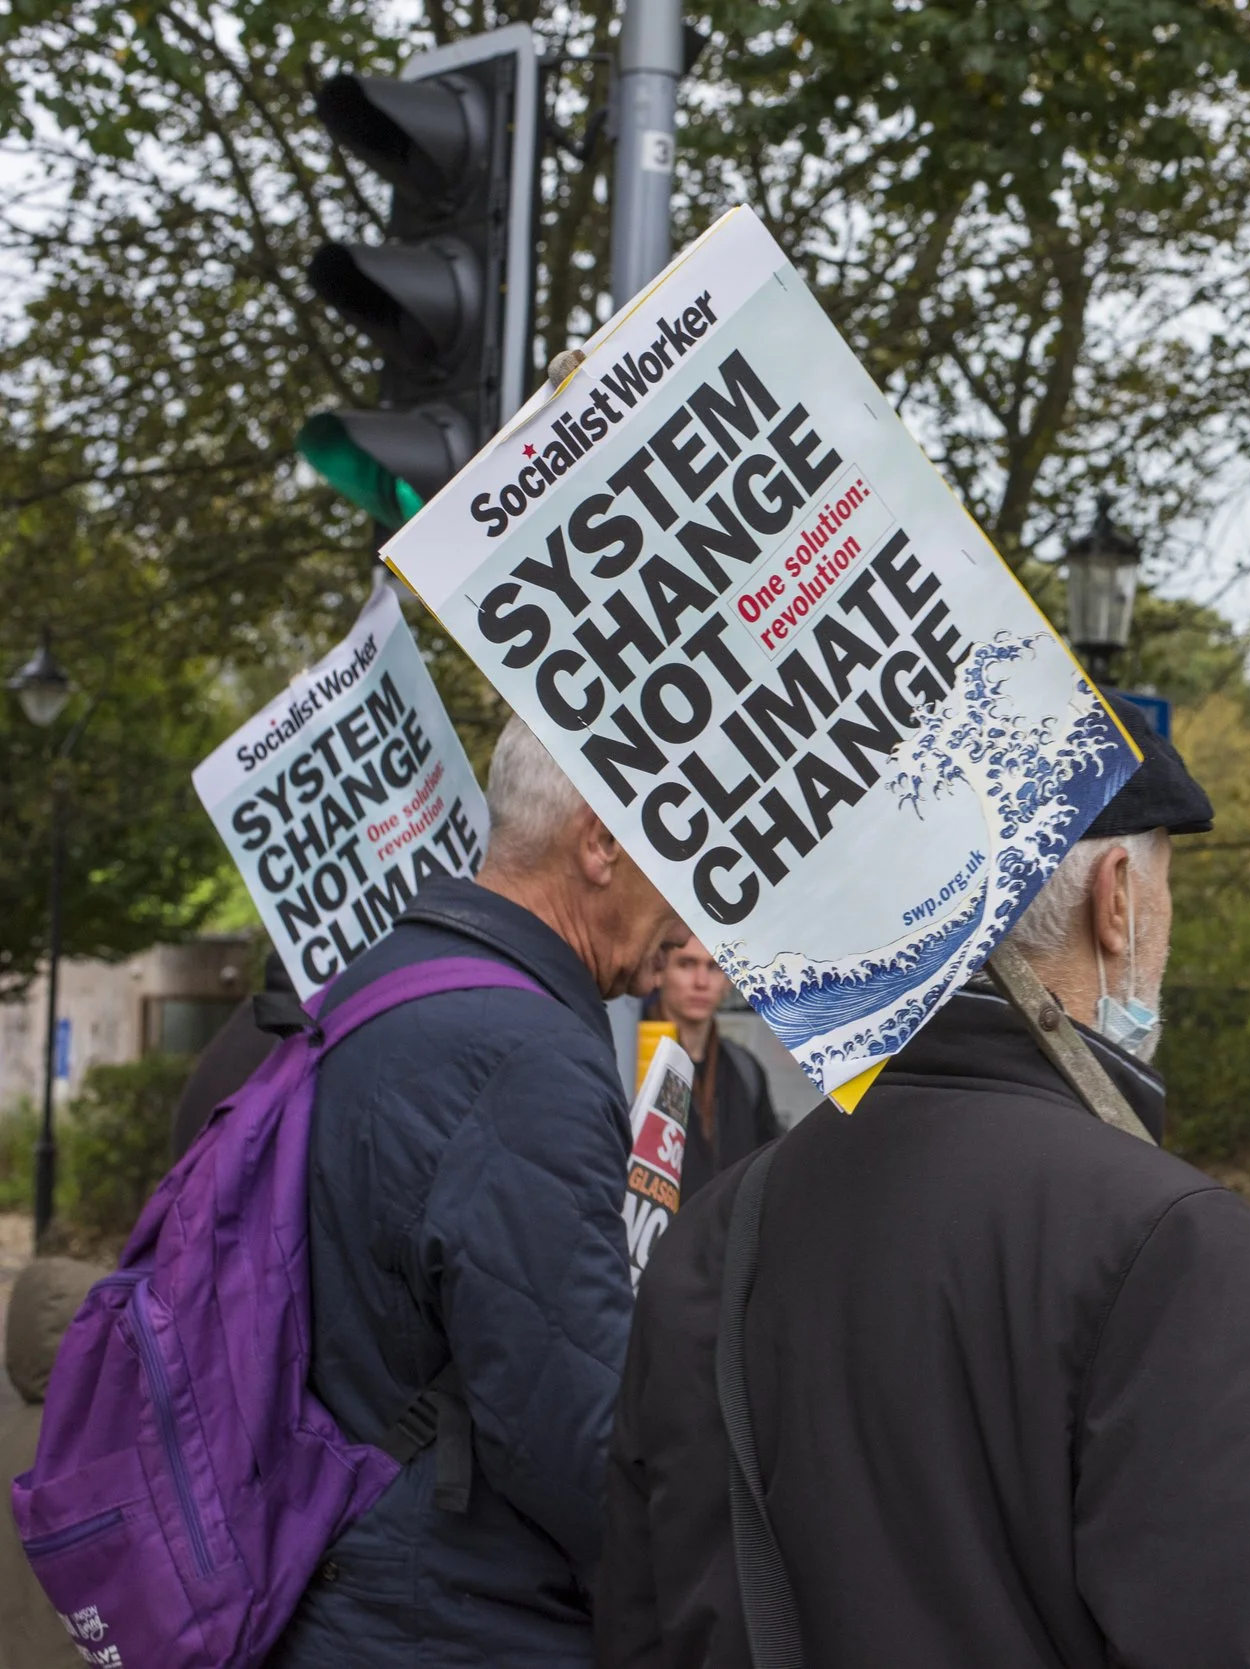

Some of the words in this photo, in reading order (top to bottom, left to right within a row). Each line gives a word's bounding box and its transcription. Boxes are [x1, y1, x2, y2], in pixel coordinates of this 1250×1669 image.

[470, 388, 624, 538] Socialist
[600, 290, 719, 409] Worker
[478, 348, 781, 669] SYSTEM
[537, 403, 843, 732] CHANGE
[737, 573, 786, 623] One
[784, 479, 871, 578] solution:
[760, 534, 862, 650] revolution
[231, 670, 406, 852] SYSTEM
[236, 690, 322, 772] Socialist
[314, 633, 379, 703] Worker
[580, 611, 753, 808] NOT
[641, 528, 942, 862] CLIMATE
[692, 599, 974, 926] CHANGE
[256, 706, 433, 894] CHANGE
[275, 833, 369, 945] NOT
[301, 796, 478, 985] CLIMATE
[366, 815, 400, 843] One
[377, 795, 445, 861] revolution
[902, 849, 986, 926] swp.org.uk
